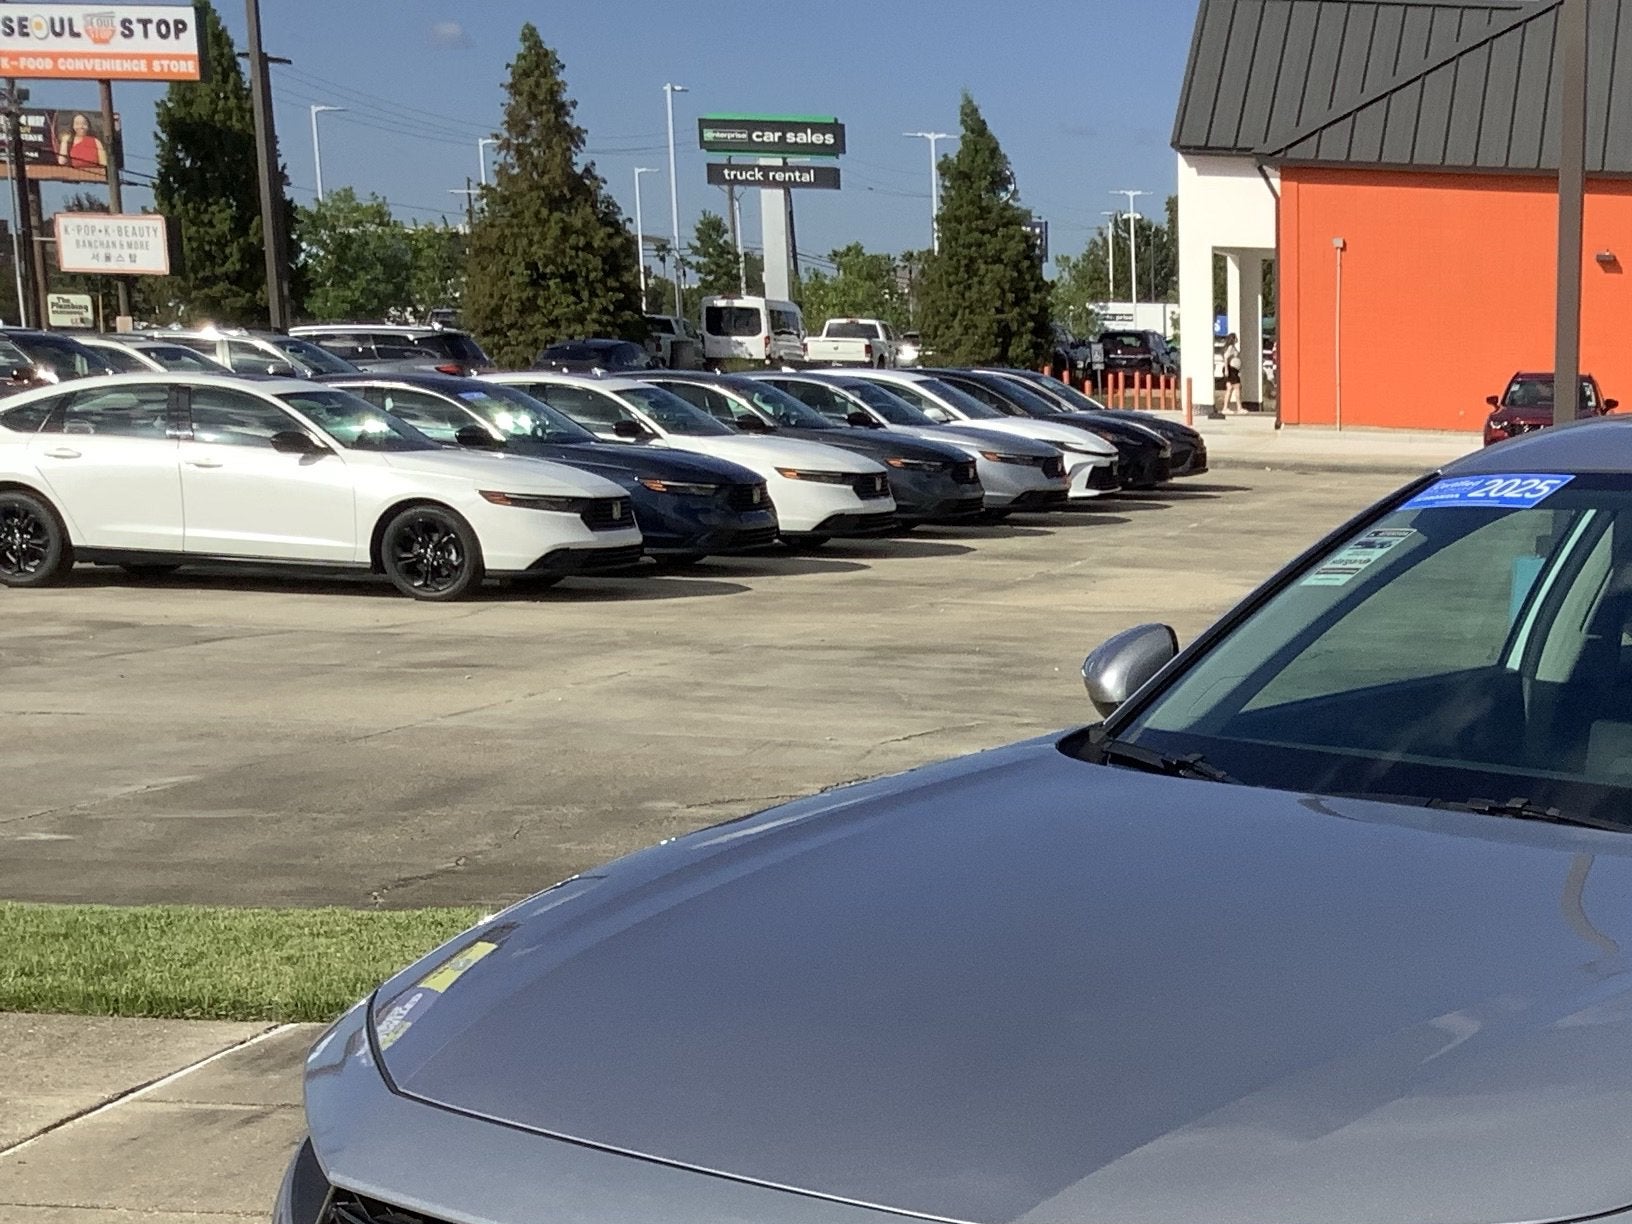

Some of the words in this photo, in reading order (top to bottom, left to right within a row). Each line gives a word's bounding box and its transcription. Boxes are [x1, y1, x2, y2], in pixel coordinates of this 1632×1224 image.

[1, 15, 81, 40] SEOUL
[120, 18, 188, 40] STOP
[0, 57, 53, 70] K-FOOD
[57, 58, 148, 72] CONVENIENCE
[152, 60, 195, 73] STORE
[752, 130, 782, 142] car
[786, 128, 835, 144] sales
[723, 167, 764, 180] truck
[769, 169, 815, 183] rental
[76, 239, 117, 250] BANCHAN
[127, 241, 150, 251] MORE
[1467, 478, 1561, 498] 2025
